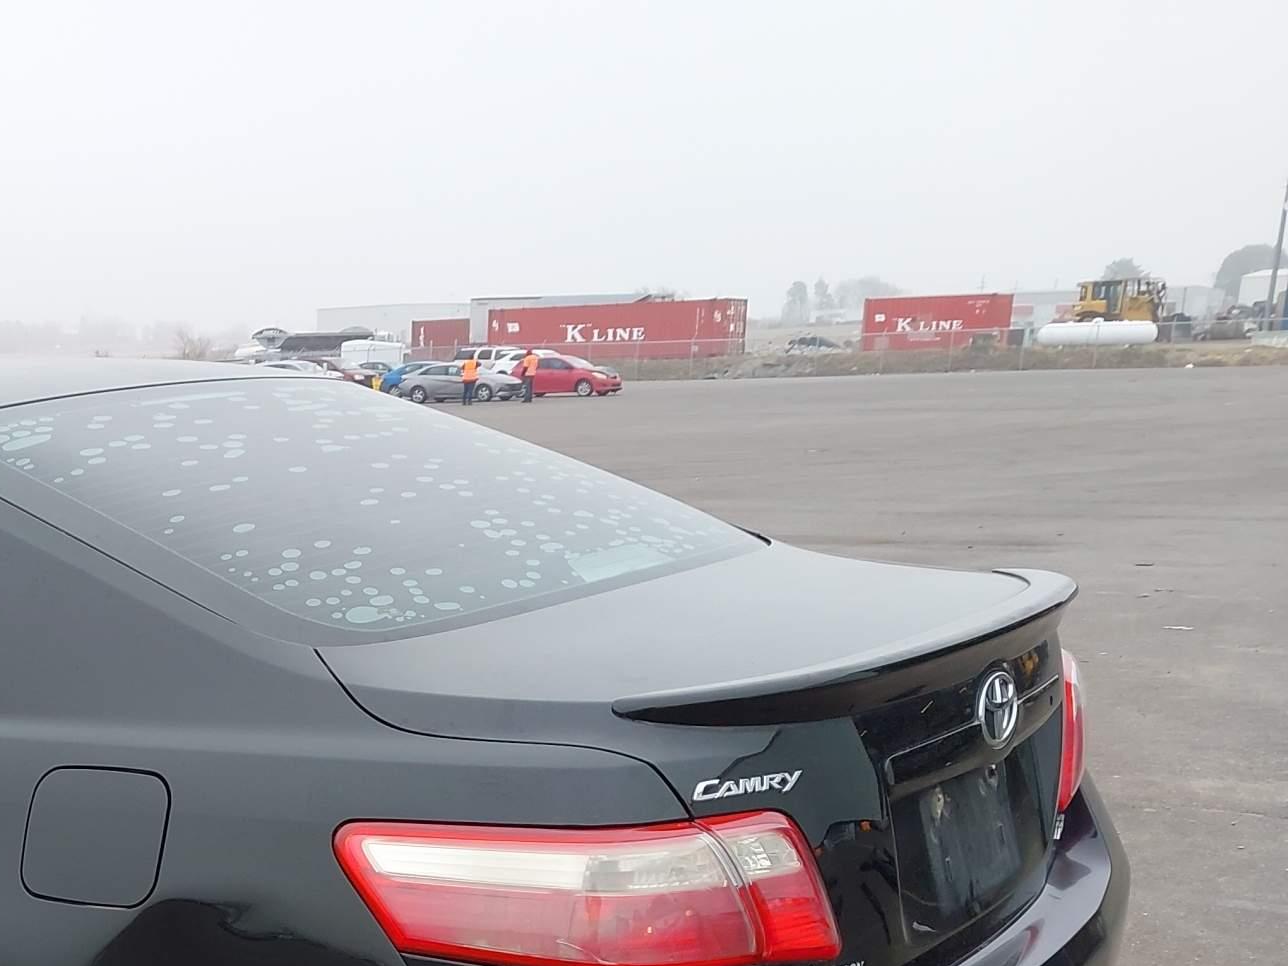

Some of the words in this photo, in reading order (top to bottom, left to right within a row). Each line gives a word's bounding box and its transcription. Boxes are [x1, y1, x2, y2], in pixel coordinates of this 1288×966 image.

[919, 319, 963, 331] LINE
[592, 327, 645, 342] LINE
[693, 769, 803, 801] CAMRY
